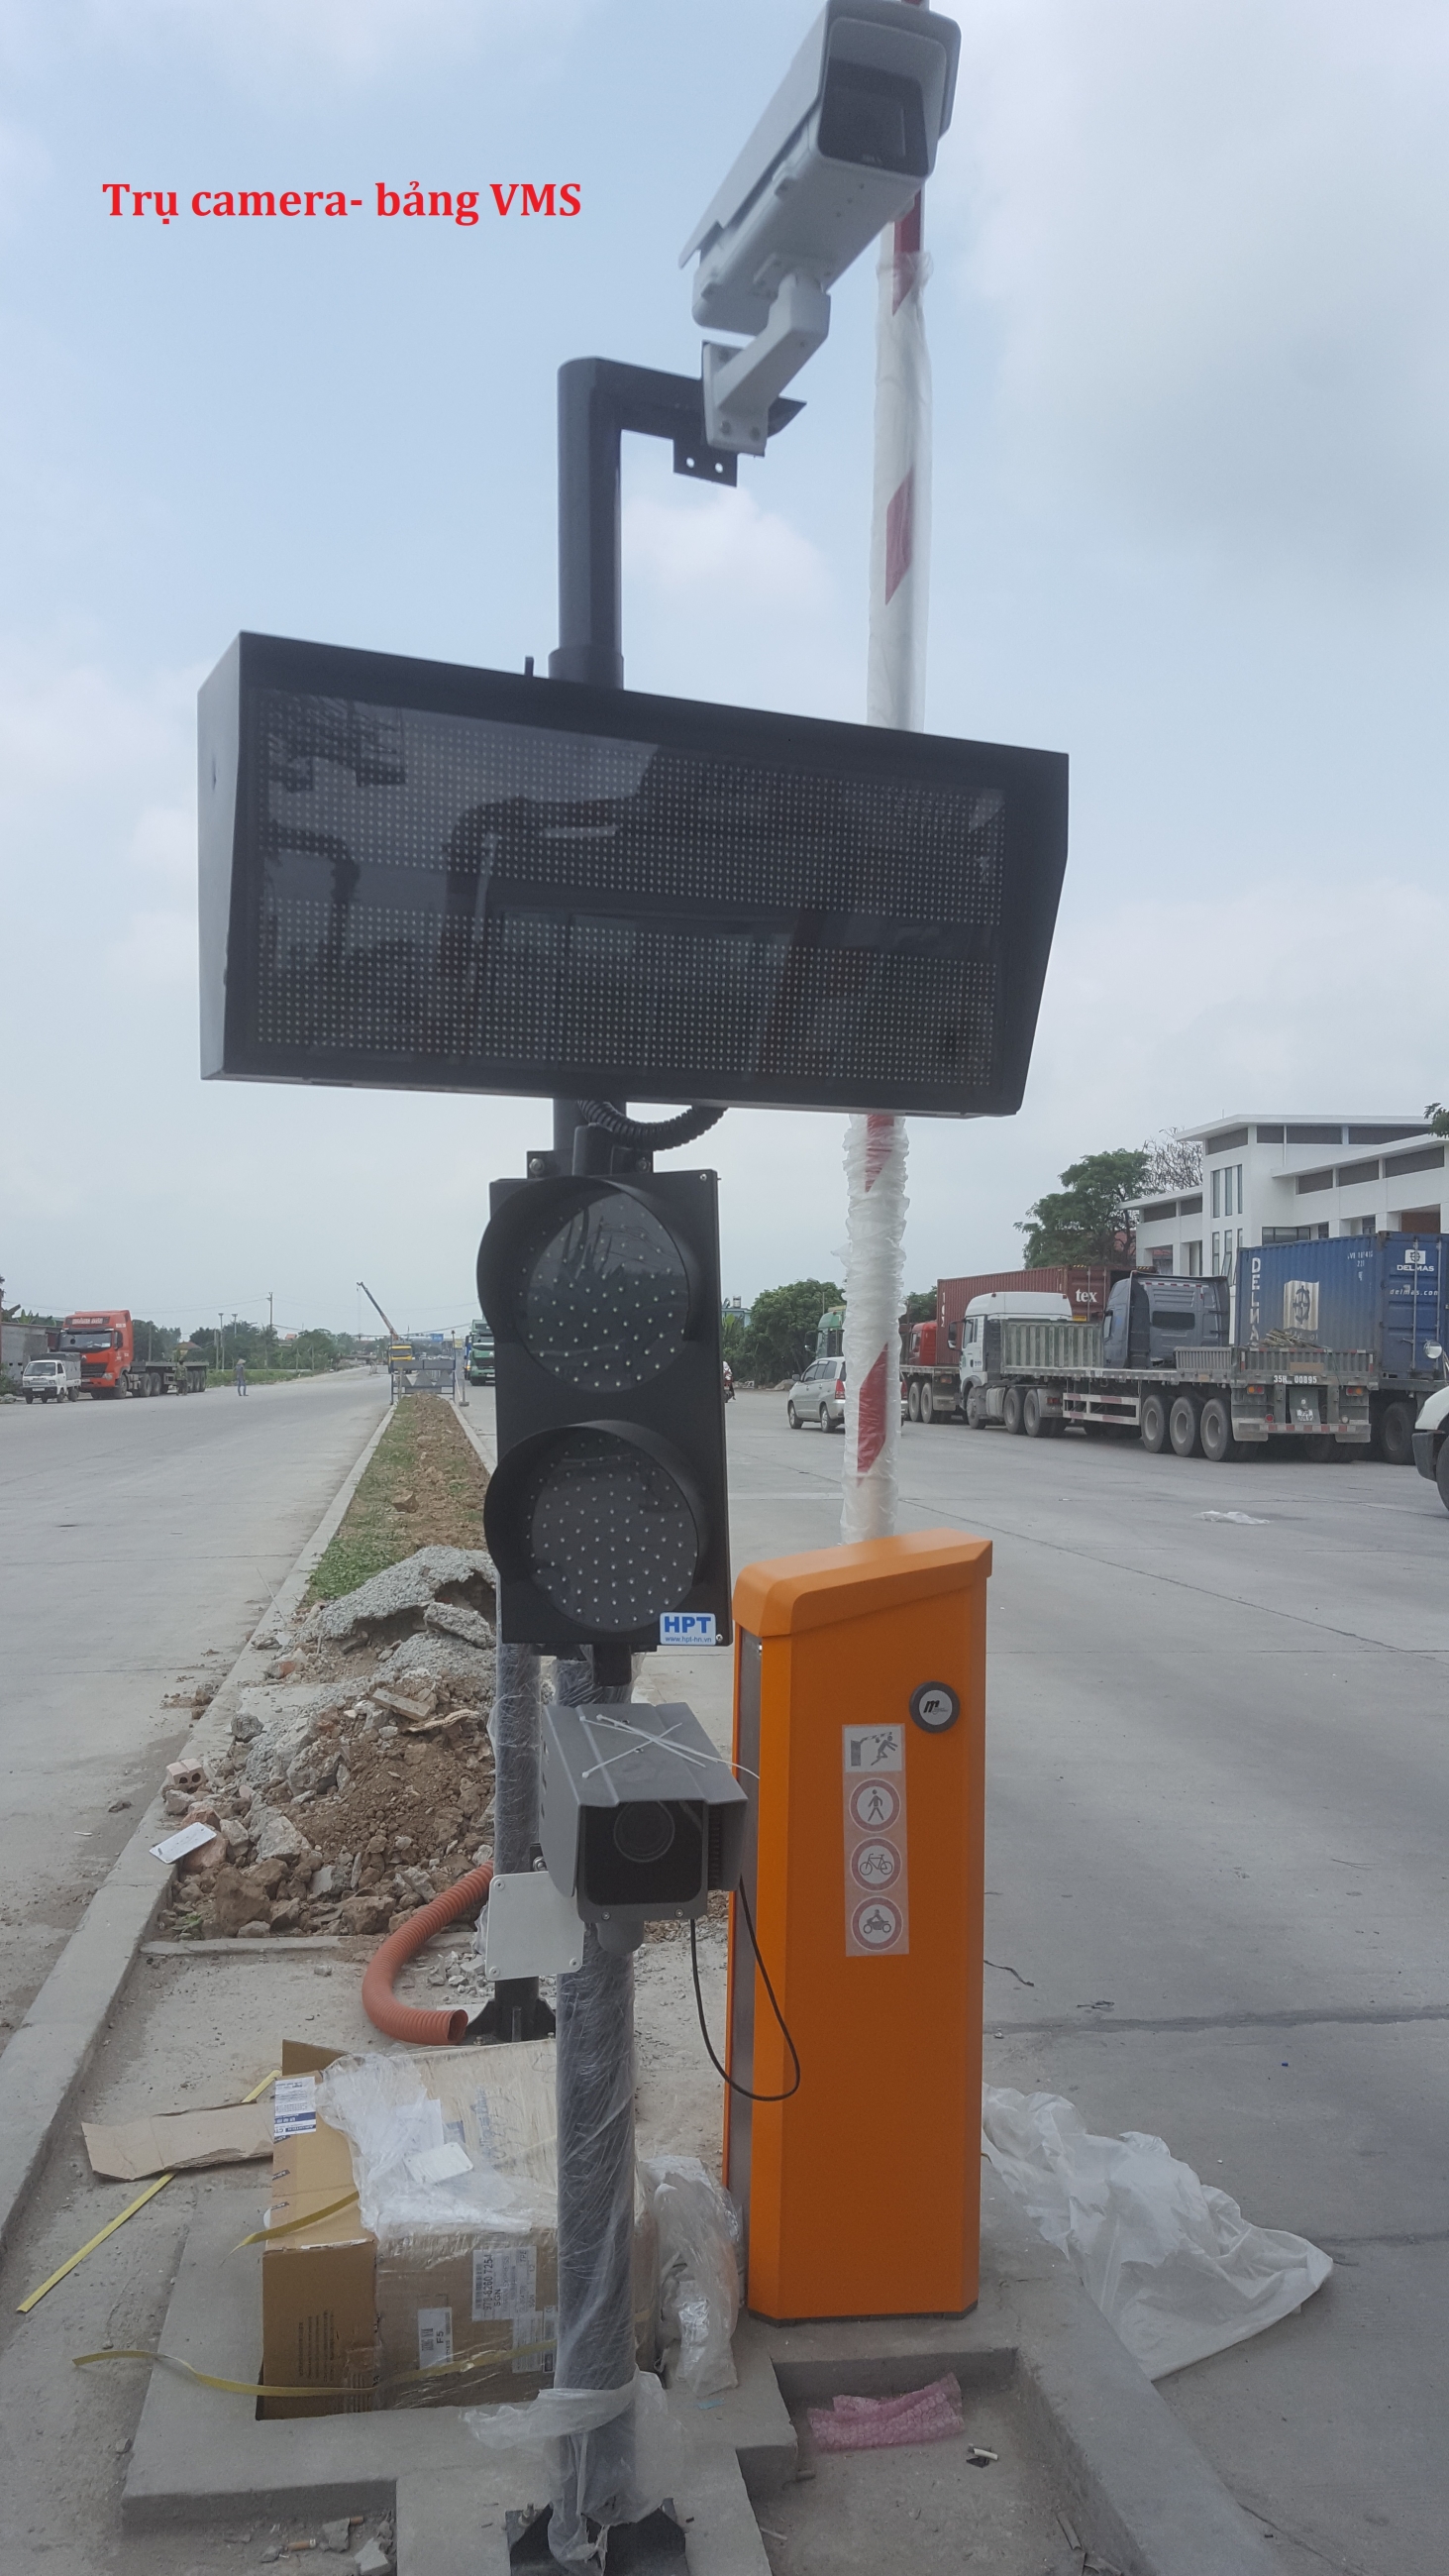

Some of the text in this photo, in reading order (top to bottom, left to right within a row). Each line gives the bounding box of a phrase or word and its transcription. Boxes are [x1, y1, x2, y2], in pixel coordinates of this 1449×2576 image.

[1076, 1288, 1097, 1303] tex
[664, 1616, 712, 1634] HPT
[436, 2330, 444, 2343] F5
